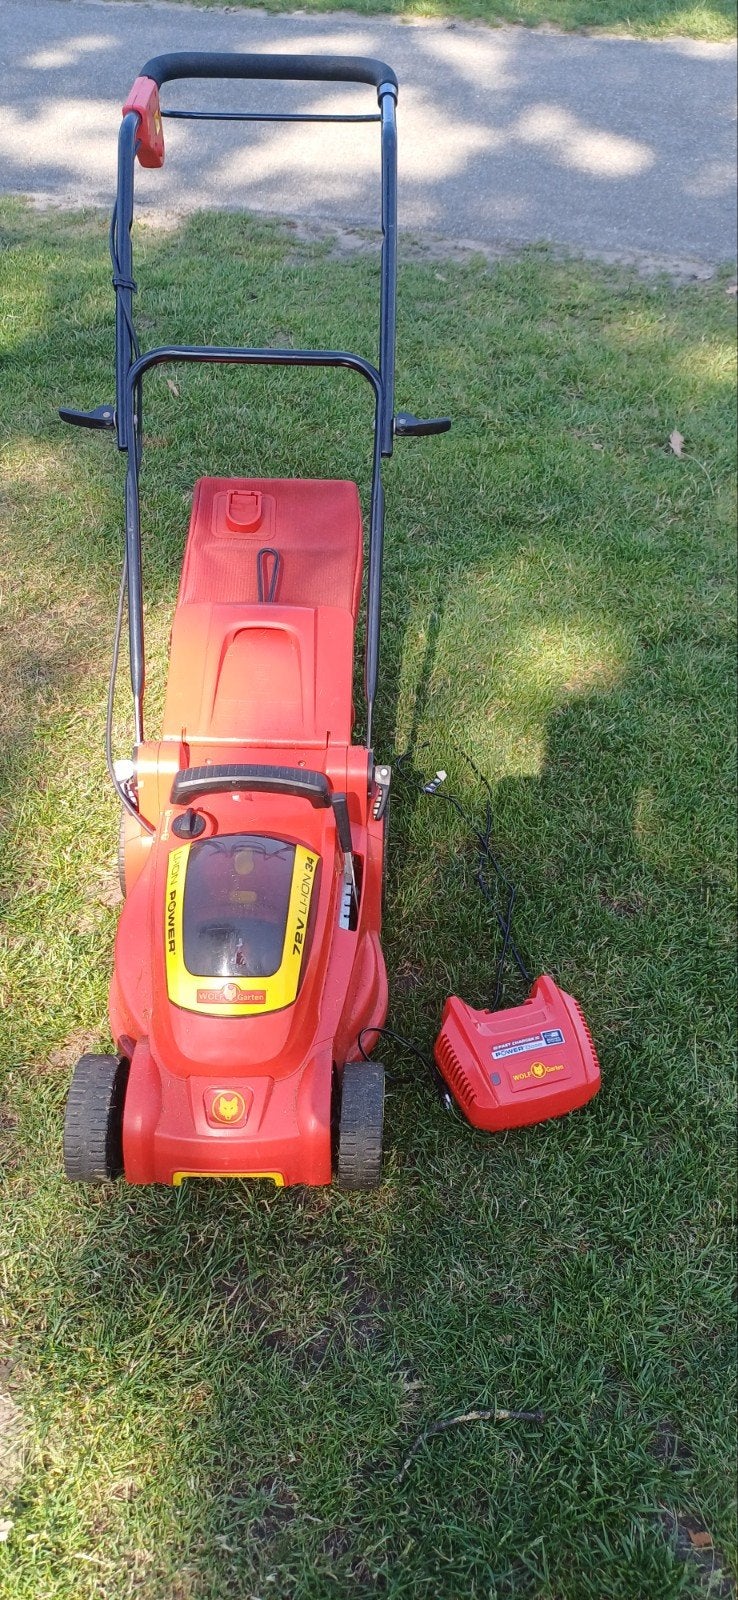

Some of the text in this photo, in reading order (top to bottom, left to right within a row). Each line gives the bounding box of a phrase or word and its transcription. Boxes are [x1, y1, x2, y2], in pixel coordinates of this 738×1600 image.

[293, 856, 315, 955] 72V LI-ION 34
[168, 890, 176, 953] POWER
[199, 992, 264, 1001] WOLF Garten
[495, 1046, 524, 1057] POWER
[513, 1071, 532, 1081] WOLF
